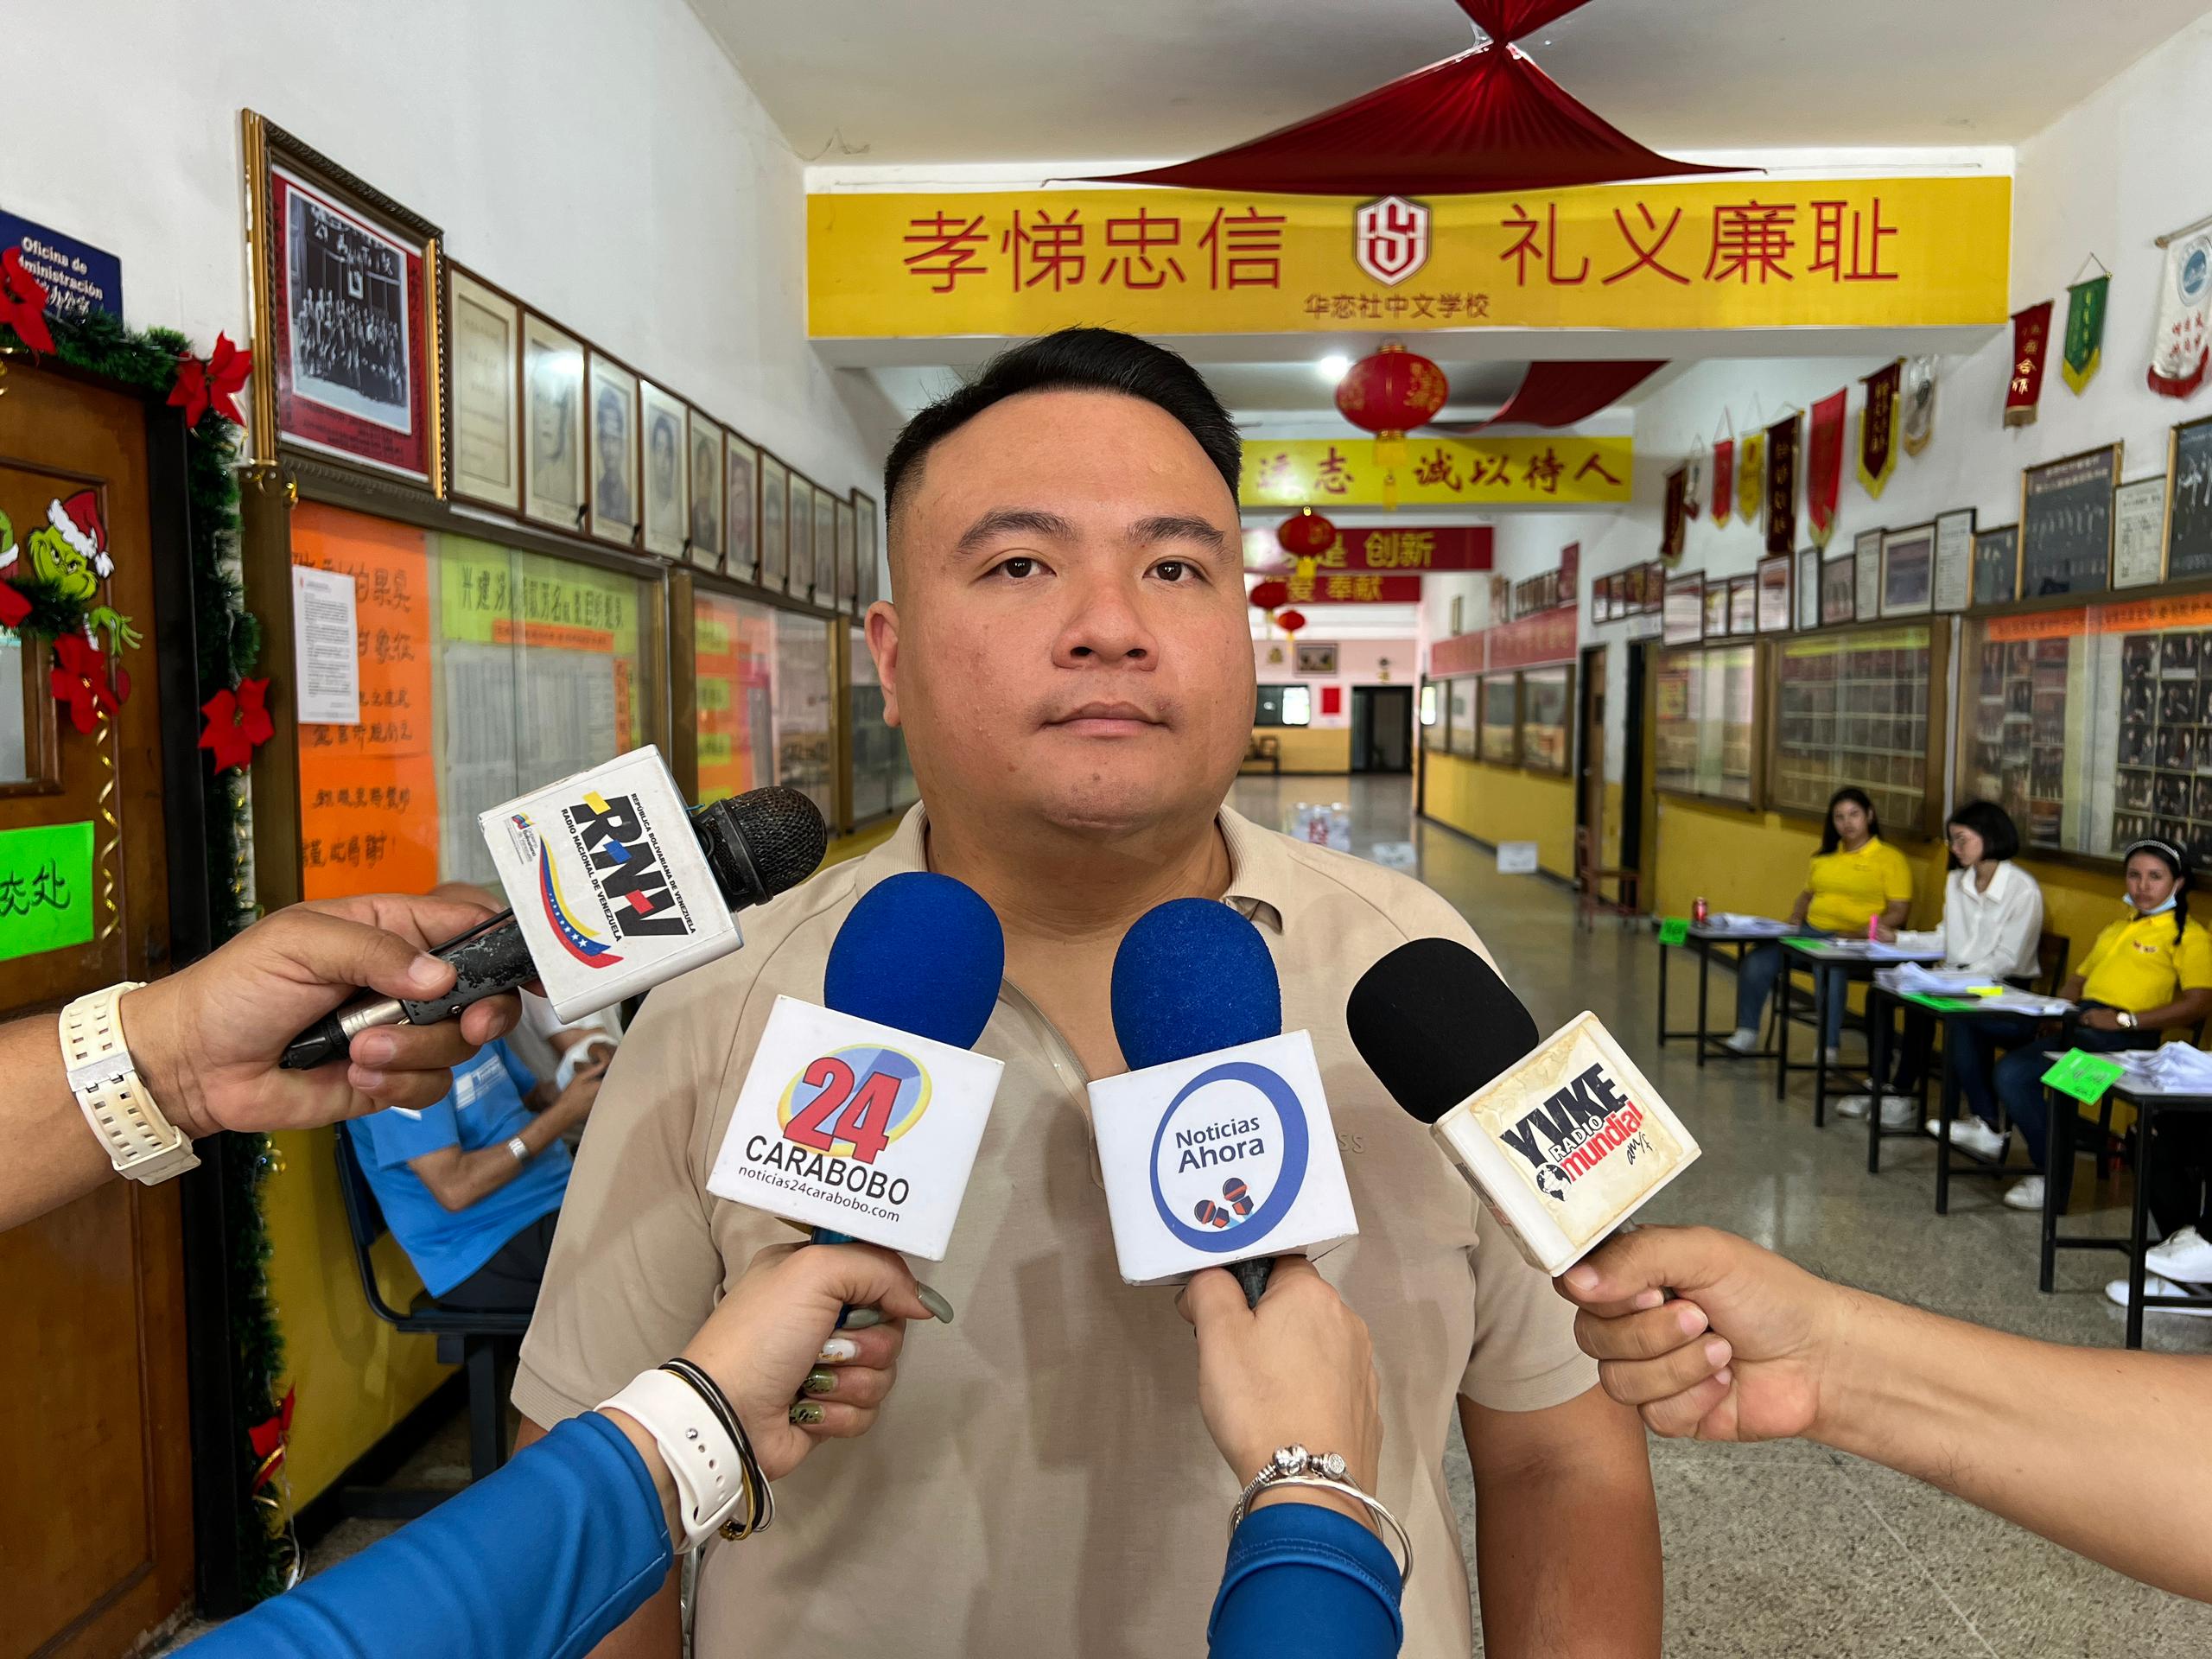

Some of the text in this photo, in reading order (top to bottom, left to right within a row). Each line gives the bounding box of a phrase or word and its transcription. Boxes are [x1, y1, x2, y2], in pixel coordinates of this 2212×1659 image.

[21, 236, 87, 276] Oficina de
[903, 207, 1287, 294] 孝悌忠信
[1500, 198, 1899, 286] 礼义廉耻
[17, 254, 104, 301] dministración
[1413, 447, 1624, 494] 诚以待人
[1363, 531, 1437, 569] 创新
[1325, 574, 1383, 602] 奉献
[561, 808, 623, 943] RADIO NACIONAL DE VENEZUELA
[569, 791, 690, 938] RNV
[630, 792, 696, 935] REPÚBLICA BOLIVARIANA DE VENEZUELA
[782, 1056, 903, 1165] 24
[1175, 1116, 1261, 1149] Noticias
[1498, 1062, 1630, 1166] YVKE
[1548, 1113, 1605, 1162] RADIO
[1559, 1100, 1644, 1183] mundial
[745, 1135, 911, 1206] CARABOBO
[1177, 1136, 1266, 1174] Ahora
[737, 1166, 901, 1224] noticias24carabobo.com
